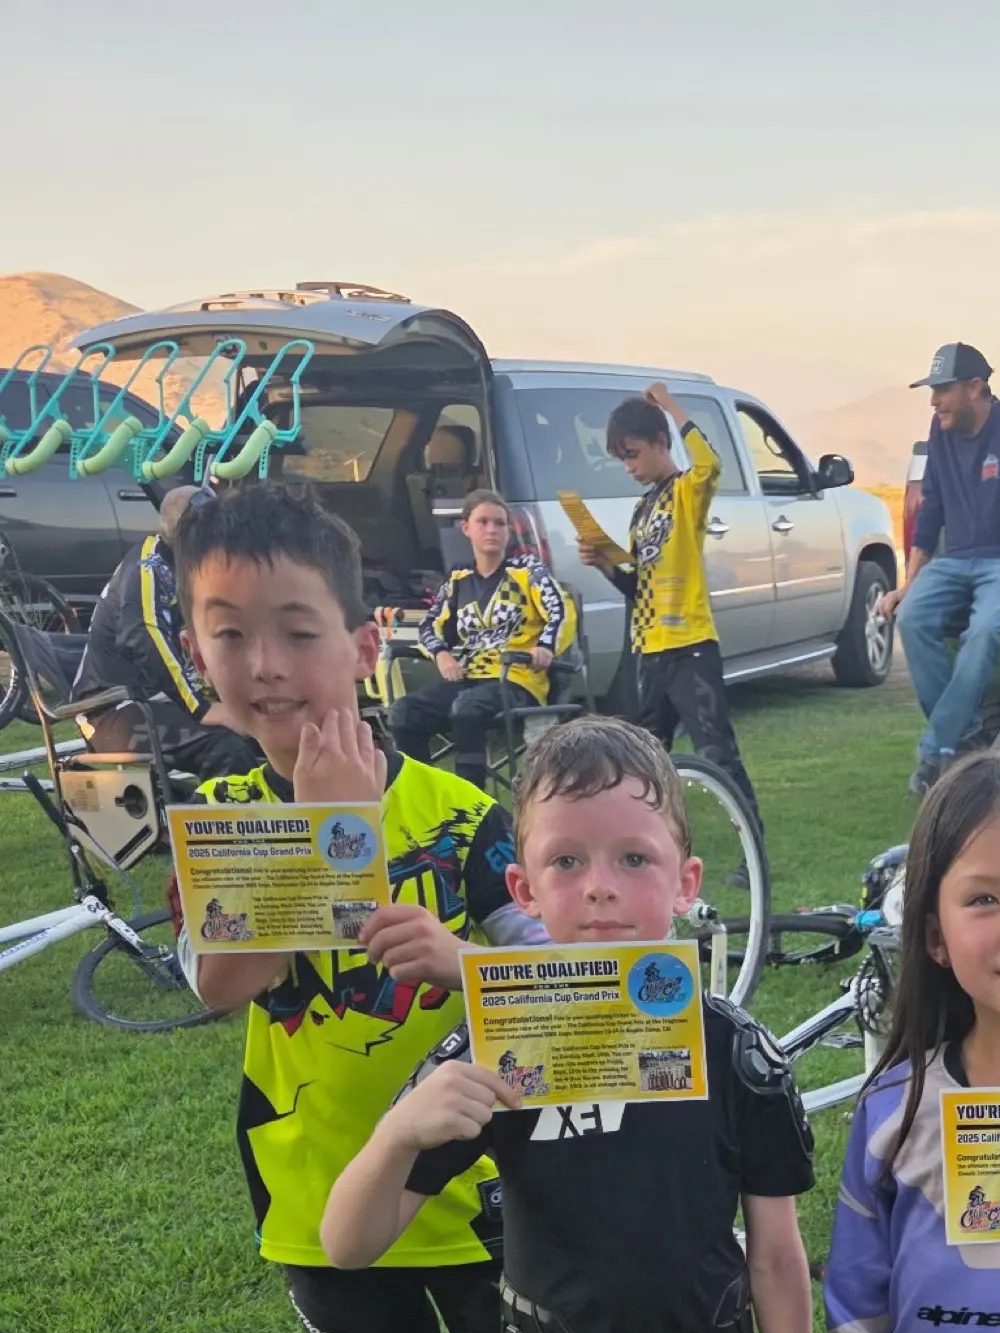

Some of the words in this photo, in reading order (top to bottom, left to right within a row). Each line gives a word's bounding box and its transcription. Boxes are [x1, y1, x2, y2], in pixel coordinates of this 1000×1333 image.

[185, 821, 233, 835] YOU'RE
[235, 819, 310, 836] QUALIFIED!
[478, 964, 533, 981] YOU'RE
[536, 960, 618, 981] QUALIFIED!
[481, 995, 505, 1006] 2025
[507, 992, 552, 1004] California
[553, 992, 571, 1004] Cup
[573, 991, 599, 1001] Grand
[601, 990, 619, 1000] Prix
[957, 1134, 979, 1143] 2025
